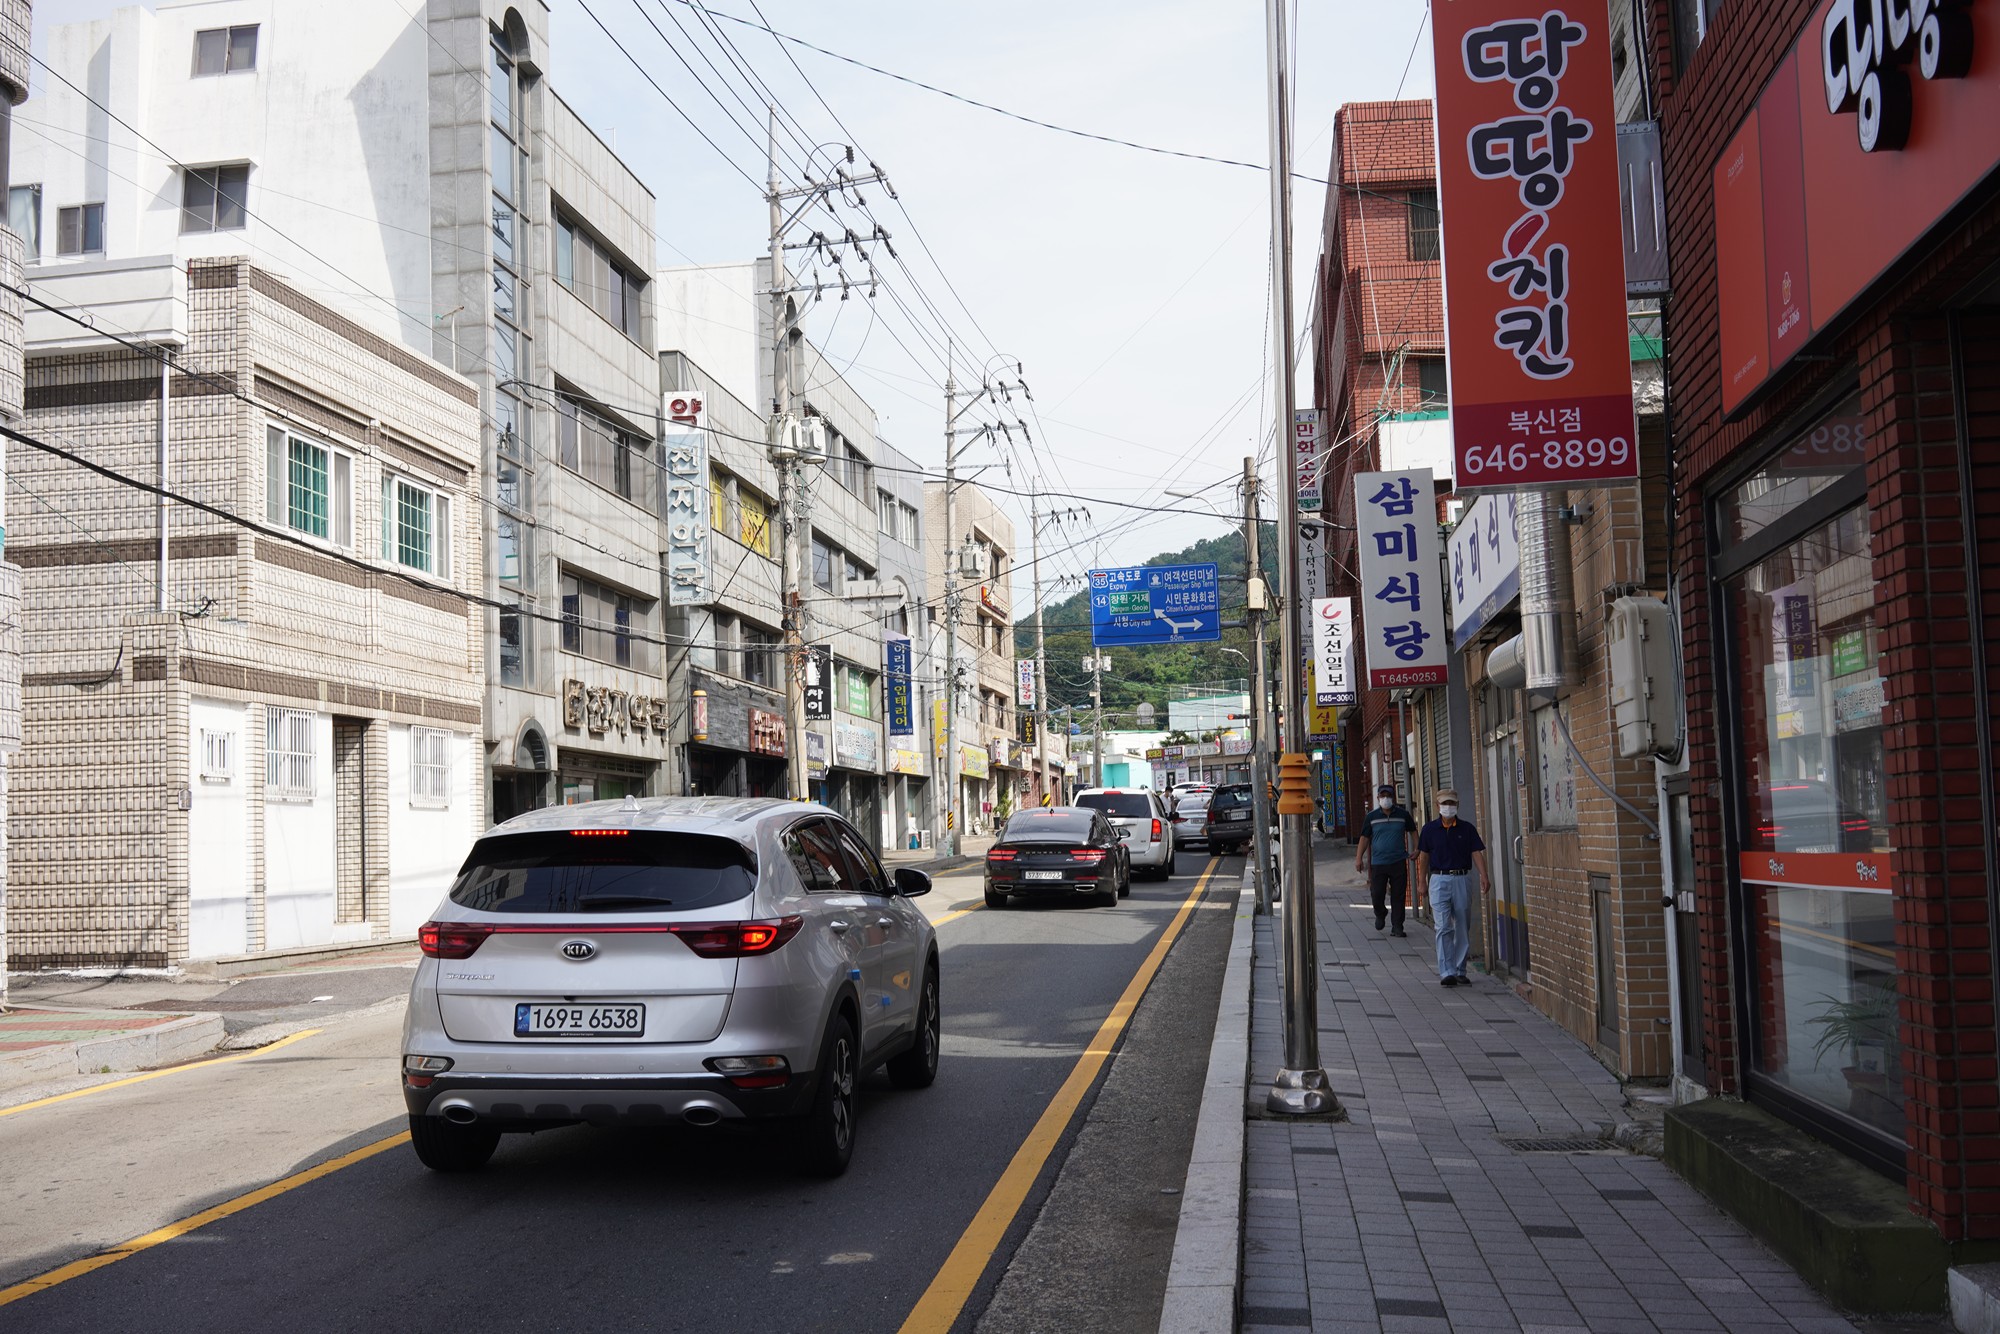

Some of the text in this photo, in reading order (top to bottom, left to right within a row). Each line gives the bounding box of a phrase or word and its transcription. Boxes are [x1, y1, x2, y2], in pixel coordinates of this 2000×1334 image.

[1461, 9, 1593, 380] 땅땅치킨
[671, 398, 702, 425] 약
[1508, 407, 1581, 436] 북신점
[1296, 423, 1316, 488] 만화소설
[1464, 437, 1628, 474] 646-8899
[1109, 570, 1141, 582] 고속도로
[1164, 568, 1213, 582] 여객선터미널
[1368, 477, 1431, 661] 삼미식당
[1095, 578, 1106, 586] 35
[1109, 583, 1127, 591] Expwy
[1096, 596, 1106, 605] 14
[1165, 590, 1215, 605] 시민문화회관
[1113, 616, 1129, 628] 시청
[1324, 623, 1345, 687] 조선일보
[1380, 672, 1437, 685] T.645-0253
[567, 945, 589, 955] KIA
[533, 1008, 638, 1029] 169모 6538
